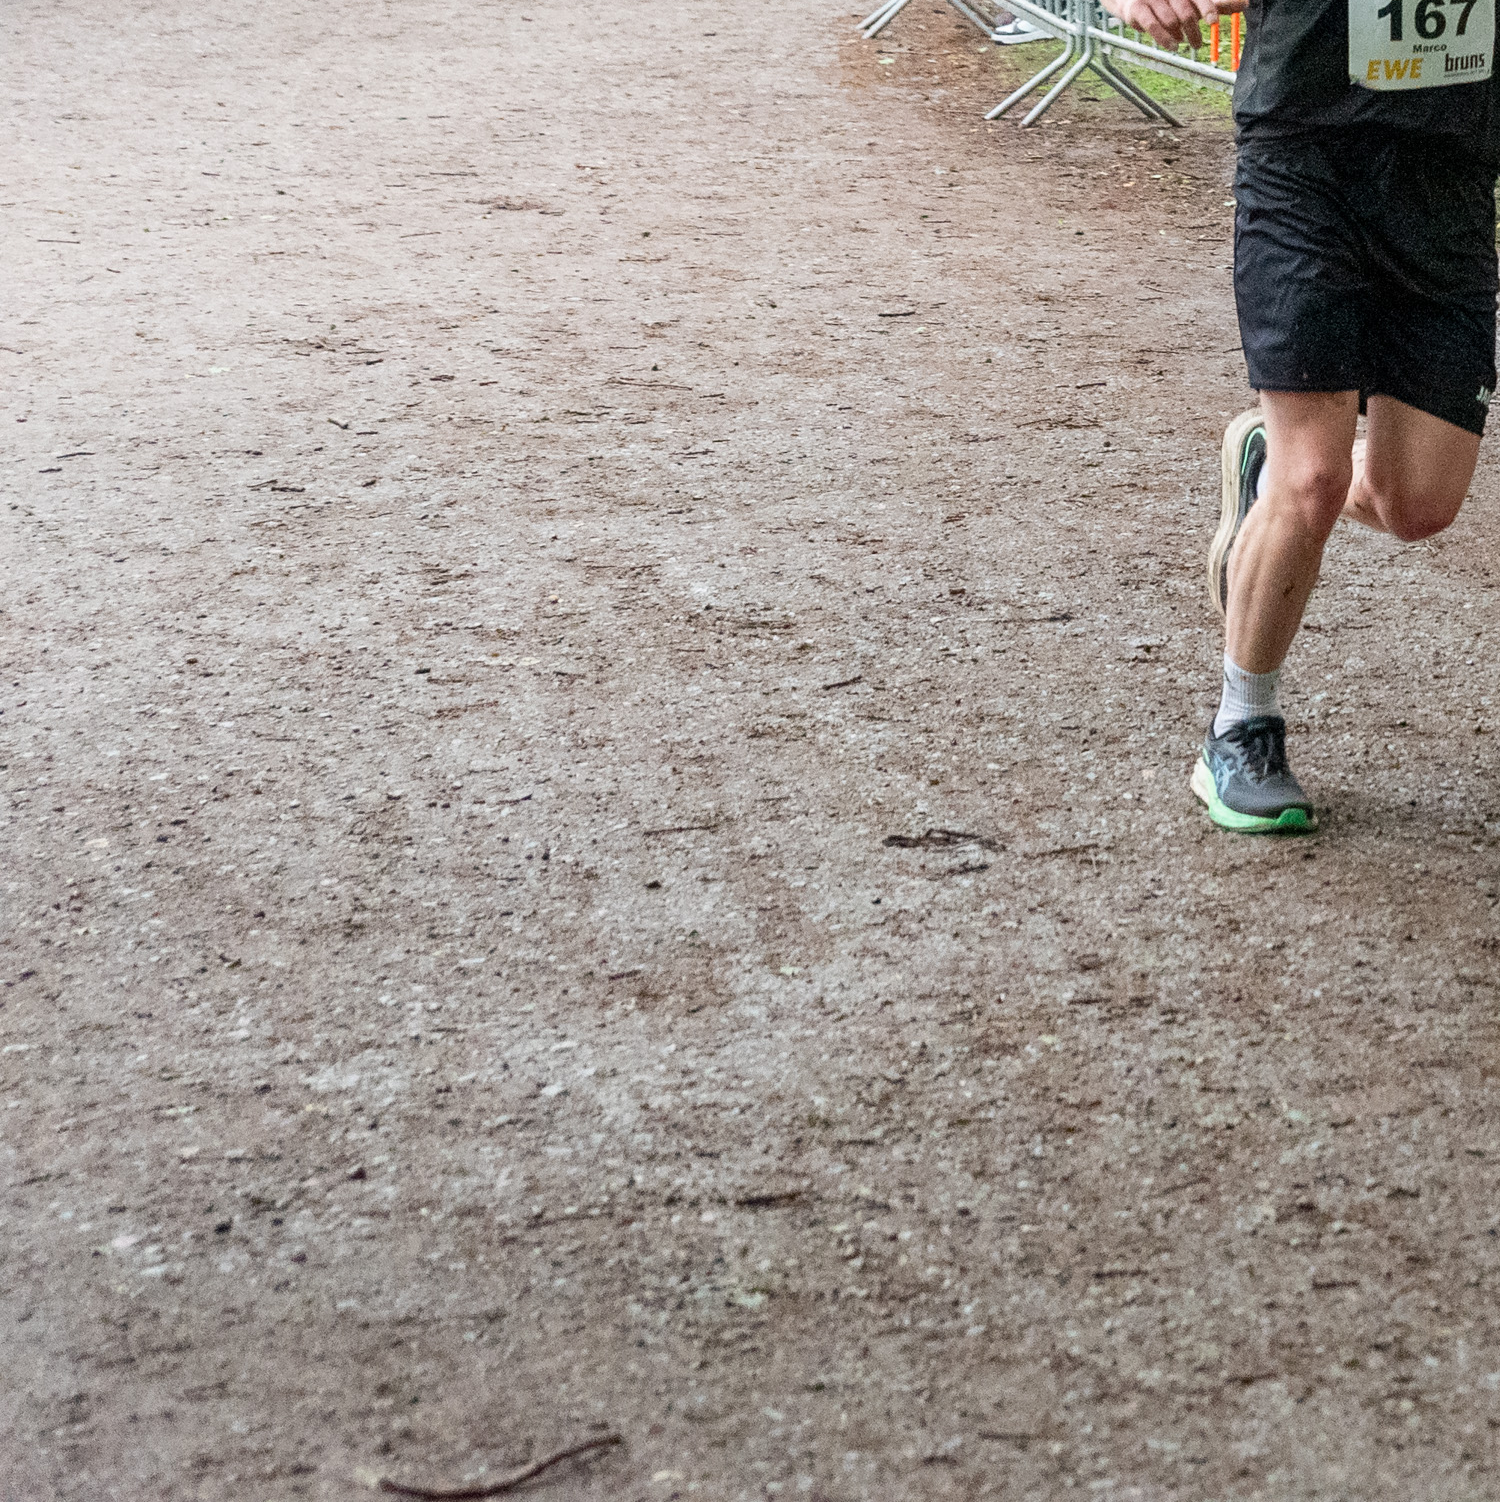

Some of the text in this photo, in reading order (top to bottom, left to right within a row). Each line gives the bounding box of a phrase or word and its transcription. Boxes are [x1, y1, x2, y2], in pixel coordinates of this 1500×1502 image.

[1412, 44, 1447, 54] Marco
[1366, 58, 1424, 81] EWE
[1444, 53, 1485, 73] bruns
